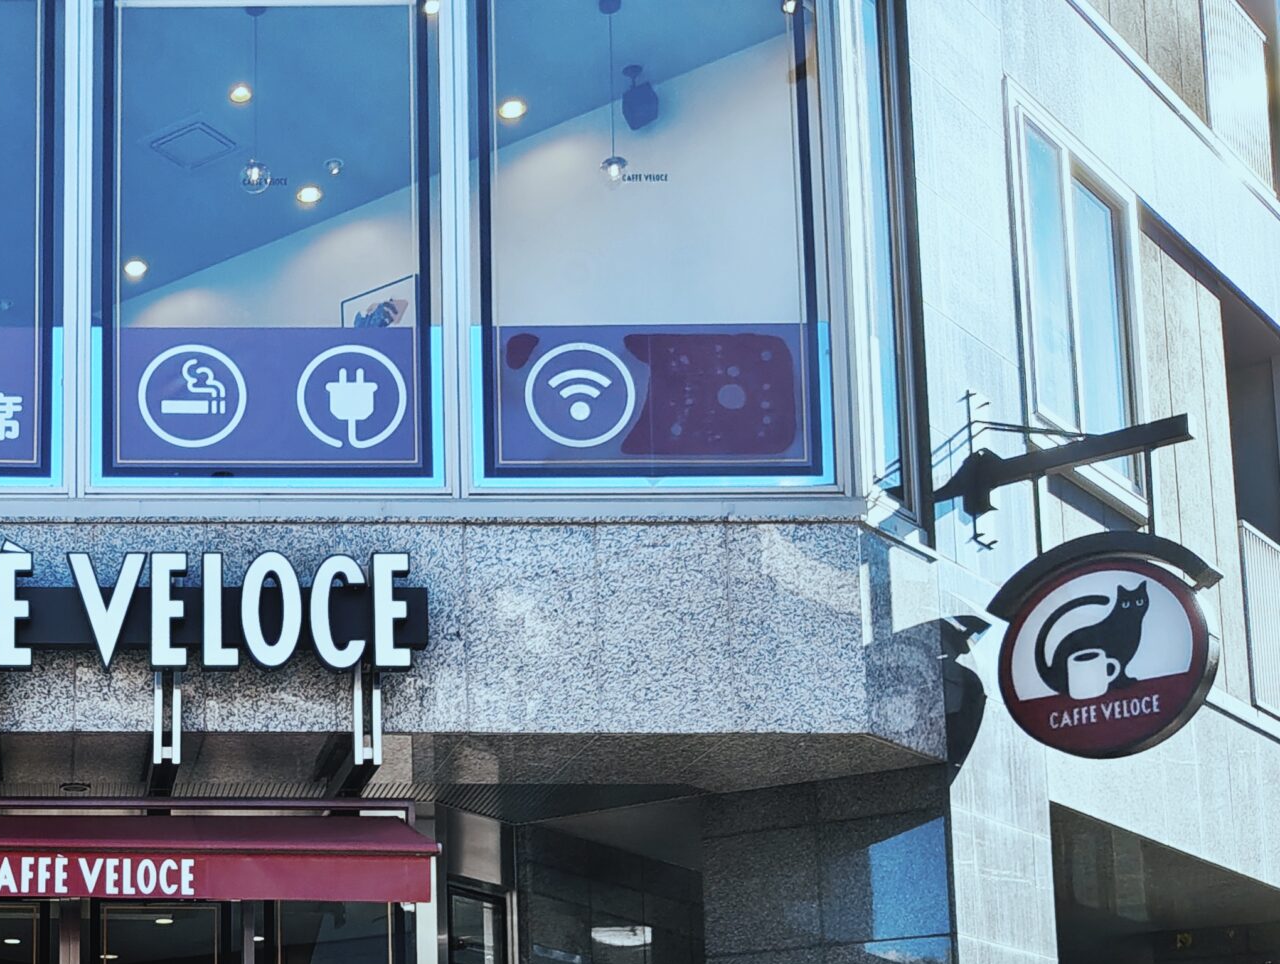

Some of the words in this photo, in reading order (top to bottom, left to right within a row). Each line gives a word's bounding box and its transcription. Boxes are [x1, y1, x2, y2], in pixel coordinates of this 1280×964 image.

[67, 551, 412, 670] VELOCE
[1101, 694, 1161, 720] VELOCE
[78, 858, 195, 896] VELOCE
